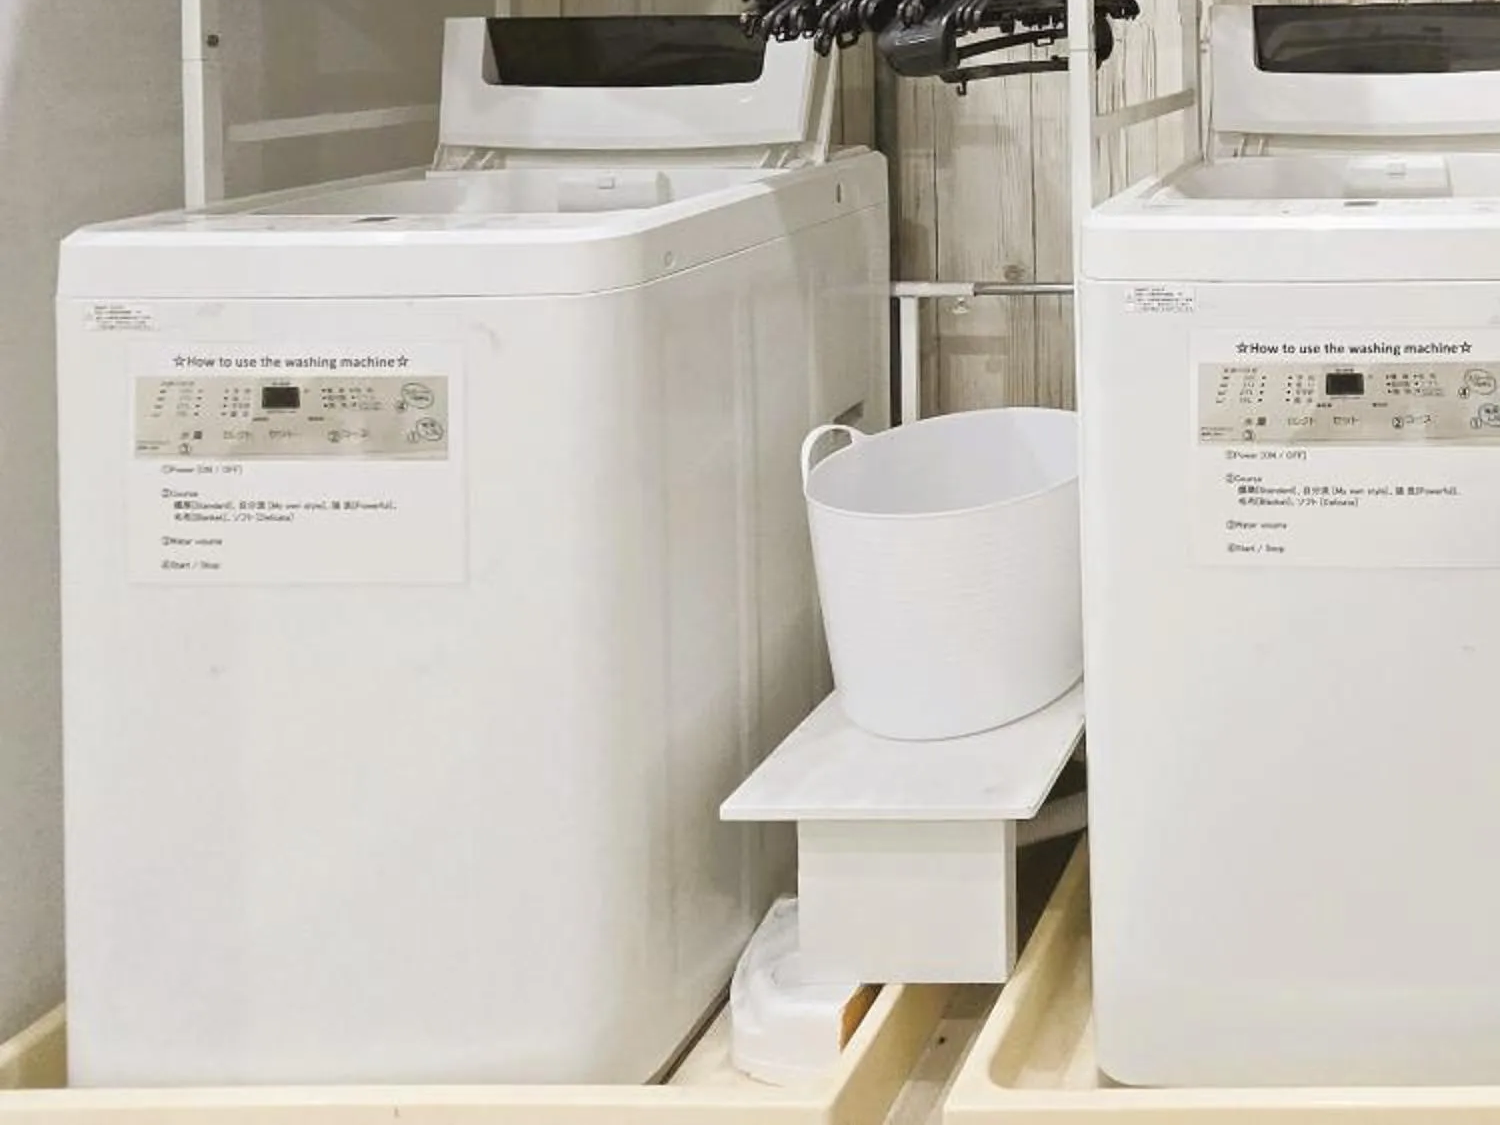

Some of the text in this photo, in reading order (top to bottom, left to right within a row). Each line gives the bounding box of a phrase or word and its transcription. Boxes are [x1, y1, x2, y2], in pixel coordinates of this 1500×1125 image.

[1250, 344, 1278, 354] How
[1282, 345, 1296, 354] to
[1325, 343, 1345, 354] the
[1350, 342, 1401, 356] washing
[1403, 343, 1459, 354] machine
[187, 355, 395, 371] How to use the washing machine
